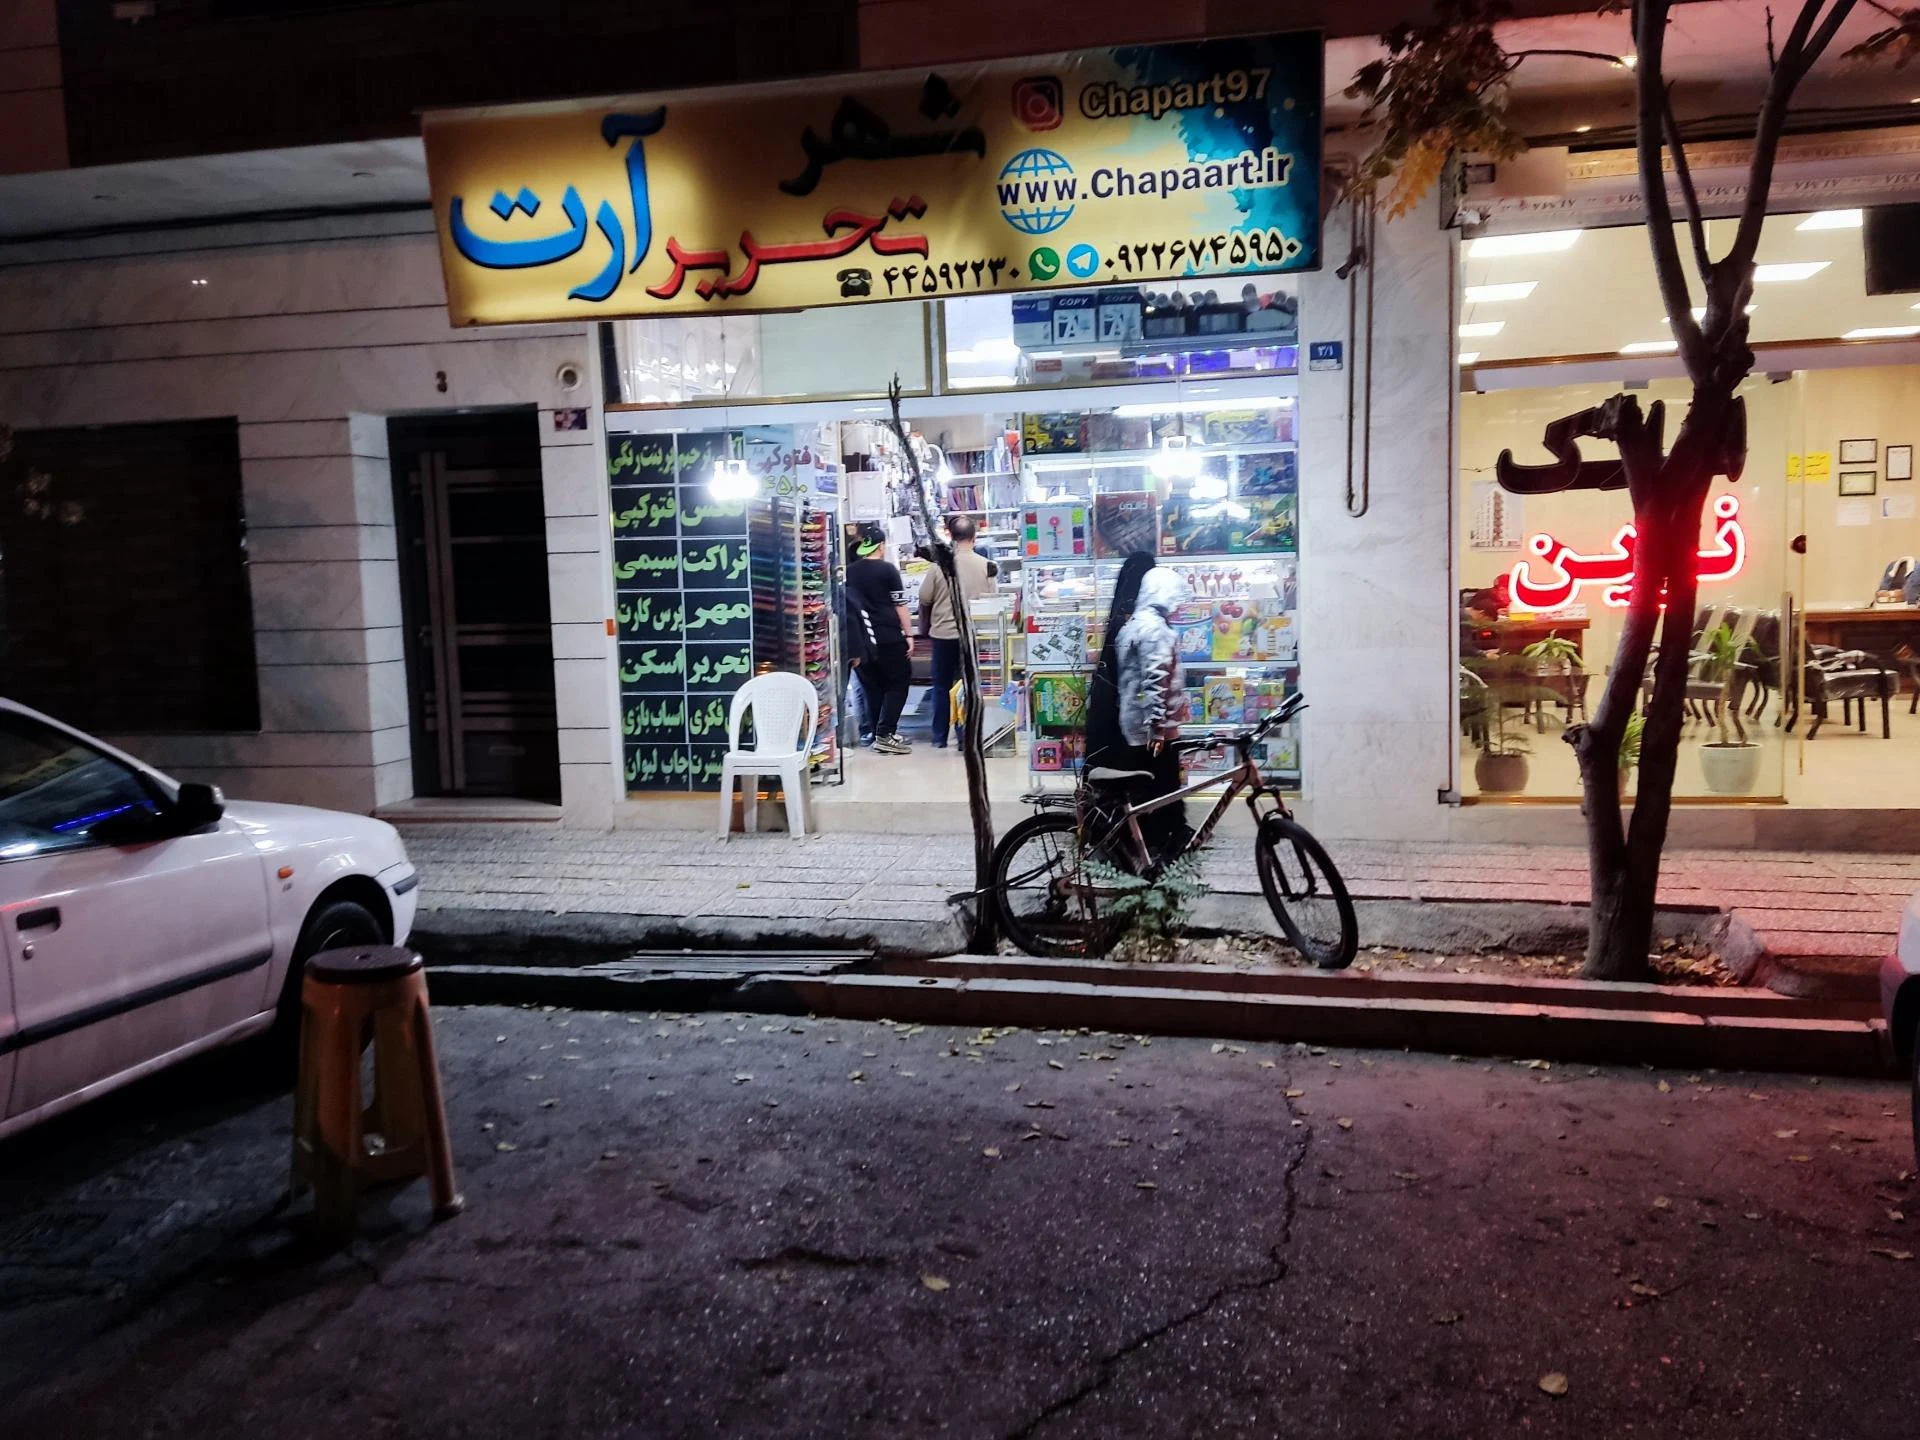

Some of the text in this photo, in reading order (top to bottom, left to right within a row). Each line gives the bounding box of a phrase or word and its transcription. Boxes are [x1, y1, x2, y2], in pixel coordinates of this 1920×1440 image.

[1078, 66, 1273, 121] Chapart97
[779, 73, 986, 197] شهر
[996, 150, 1292, 207] www.Chapaart.ir
[449, 105, 929, 301] تحریر آرت
[1104, 231, 1299, 273] ۰۹۲۲۶۷۴۵۹۵۰
[882, 256, 1021, 296] ۴۴۵۹۲۲۳۰
[1058, 296, 1089, 306] COPY
[608, 440, 642, 476] رنگی
[613, 489, 676, 528] فتوکپی
[614, 547, 679, 580] سیمی
[682, 544, 749, 580] تراکت
[617, 596, 683, 632] پرس کارت
[685, 602, 751, 629] مهر
[619, 647, 685, 683] اسکن
[687, 647, 750, 684] تحریر
[689, 697, 725, 735] فکری
[625, 747, 690, 784] چاپ لیوان
